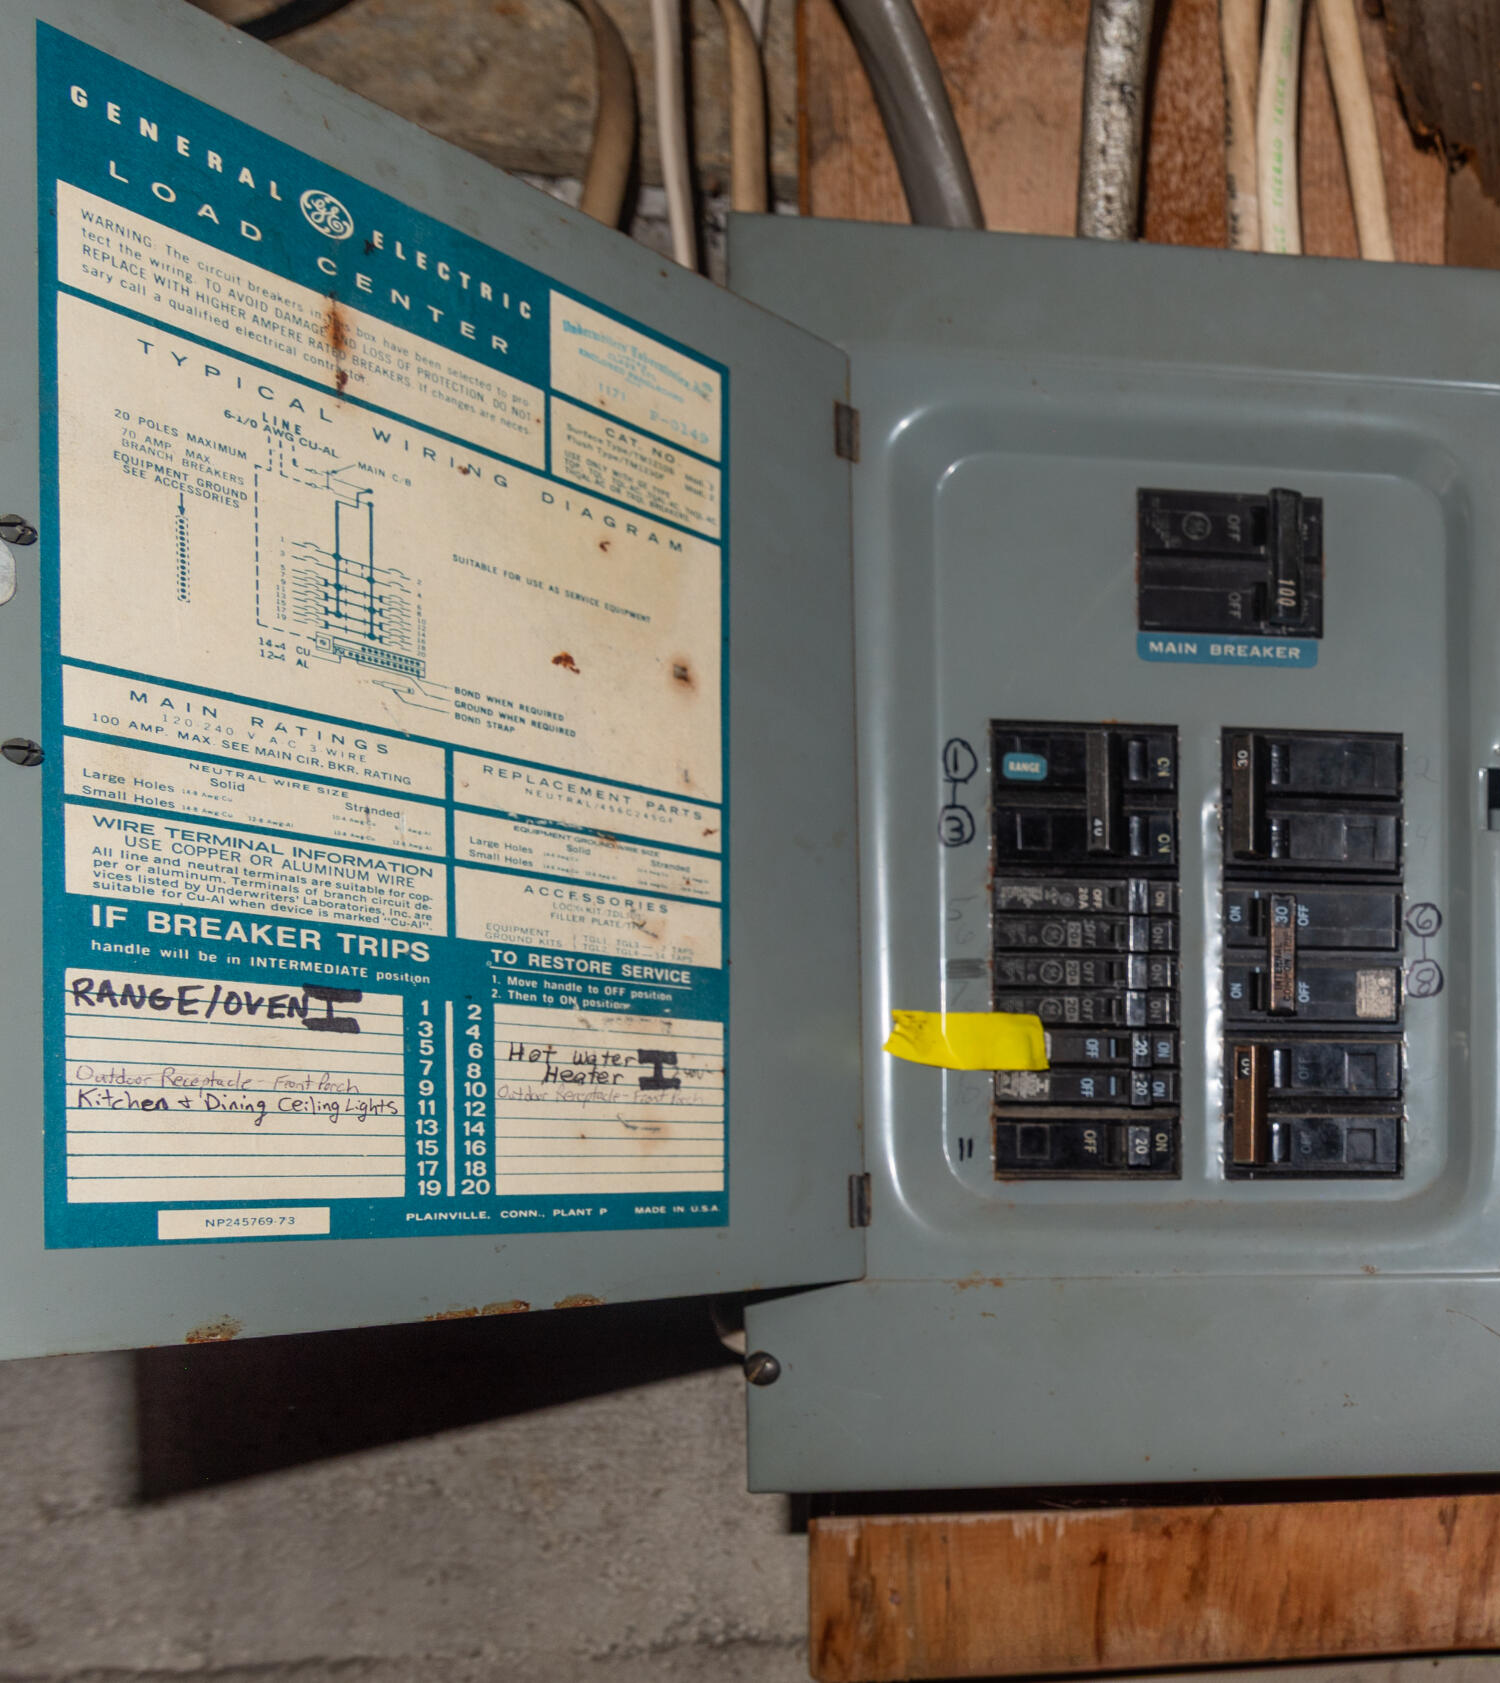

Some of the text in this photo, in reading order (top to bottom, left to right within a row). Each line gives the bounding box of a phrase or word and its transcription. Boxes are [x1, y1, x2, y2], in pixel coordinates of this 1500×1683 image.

[70, 85, 532, 320] GENERAL ELECTRIC
[109, 160, 509, 354] LOAD CENTER
[81, 227, 111, 248] tect
[119, 243, 142, 260] the
[205, 278, 221, 293] TO
[228, 289, 269, 313] AVOID
[275, 307, 327, 337] DAMAGE
[363, 344, 392, 365] LOSS
[397, 358, 412, 372] OF
[81, 262, 297, 356] sary call qualified electrical
[82, 244, 147, 280] REPLACE
[153, 273, 190, 297] WITH
[196, 291, 246, 320] HIGHER
[252, 314, 303, 344] AMPERE
[431, 389, 476, 414] changes
[166, 244, 492, 391] The circuit breakers box have been selected
[114, 408, 247, 460] 20 POLES MAXIMUM
[136, 338, 334, 424] TYPICAL
[372, 427, 508, 488] WIRING
[541, 490, 683, 553] DIAGRAM
[121, 438, 245, 486] BRANCH BREAKERS
[113, 450, 248, 501] EQUIPMENT GROUND
[154, 475, 240, 509] ACCESSORIES
[1226, 514, 1242, 542] OFF
[1228, 591, 1243, 619] OFF
[1277, 579, 1297, 607] 100
[1148, 641, 1301, 660] MAIN BREAKER
[454, 700, 495, 717] GROUND
[130, 690, 389, 755] MAIN RATINGS
[92, 712, 412, 786] 100 MAIN RATING
[1008, 761, 1041, 774] RANGE
[1157, 756, 1171, 777] ON
[82, 768, 175, 793] Large Holes
[189, 762, 350, 799] NEUTRAL WIRE SIZE
[209, 777, 245, 793] Solid
[482, 764, 703, 821] REPLACEMENT PARTS
[82, 785, 175, 809] Small Holes
[344, 802, 401, 820] Stranded
[92, 815, 433, 878] WIRE TERMINAL INFORMATION
[1157, 833, 1171, 853] ON
[124, 835, 416, 889] USE COPPER ALUMINUM WIRE
[138, 873, 179, 889] listed
[147, 865, 411, 910] aluminum. Terminals branch circuit
[188, 860, 385, 896] neutral terminals suitable
[92, 880, 380, 924] suitable device marked
[524, 884, 669, 914] ACCESSORIES
[1229, 905, 1241, 922] ON
[1275, 906, 1289, 924] 30
[1297, 903, 1310, 926] OFF
[91, 903, 431, 963] IF BREAKER TRIPS
[91, 939, 431, 984] handle will be INTERMEDIATE position
[491, 949, 691, 984] TO RESTORE SERVICE
[72, 977, 309, 1019] RANGE/OVEN
[507, 976, 627, 997] Move handle OFF
[508, 990, 537, 1003] Then
[1230, 982, 1242, 999] ON
[1298, 981, 1310, 1004] OFF
[421, 1000, 430, 1015] 1
[418, 1022, 434, 1038] 3
[419, 1040, 434, 1056] 5
[508, 1041, 558, 1065] Hot
[1085, 1037, 1099, 1060] OFF
[1157, 1041, 1171, 1059] ON
[418, 1060, 433, 1075] 7
[542, 1064, 625, 1086] Heater
[76, 1065, 153, 1086] Outdoor
[161, 1066, 252, 1095] Receptacle
[419, 1080, 434, 1096] 9
[1080, 1076, 1094, 1098] OFF
[1152, 1080, 1166, 1098] ON
[76, 1087, 398, 1126] Kitchen Dining Ceiling Lights
[418, 1100, 436, 1116] 11
[415, 1119, 439, 1136] 13
[415, 1139, 439, 1156] 15
[1084, 1128, 1098, 1154] OFF
[1136, 1137, 1149, 1155] 20
[1155, 1132, 1168, 1153] ON
[416, 1161, 439, 1176] 17
[417, 1180, 442, 1196] 19
[552, 1207, 593, 1218] PLANT
